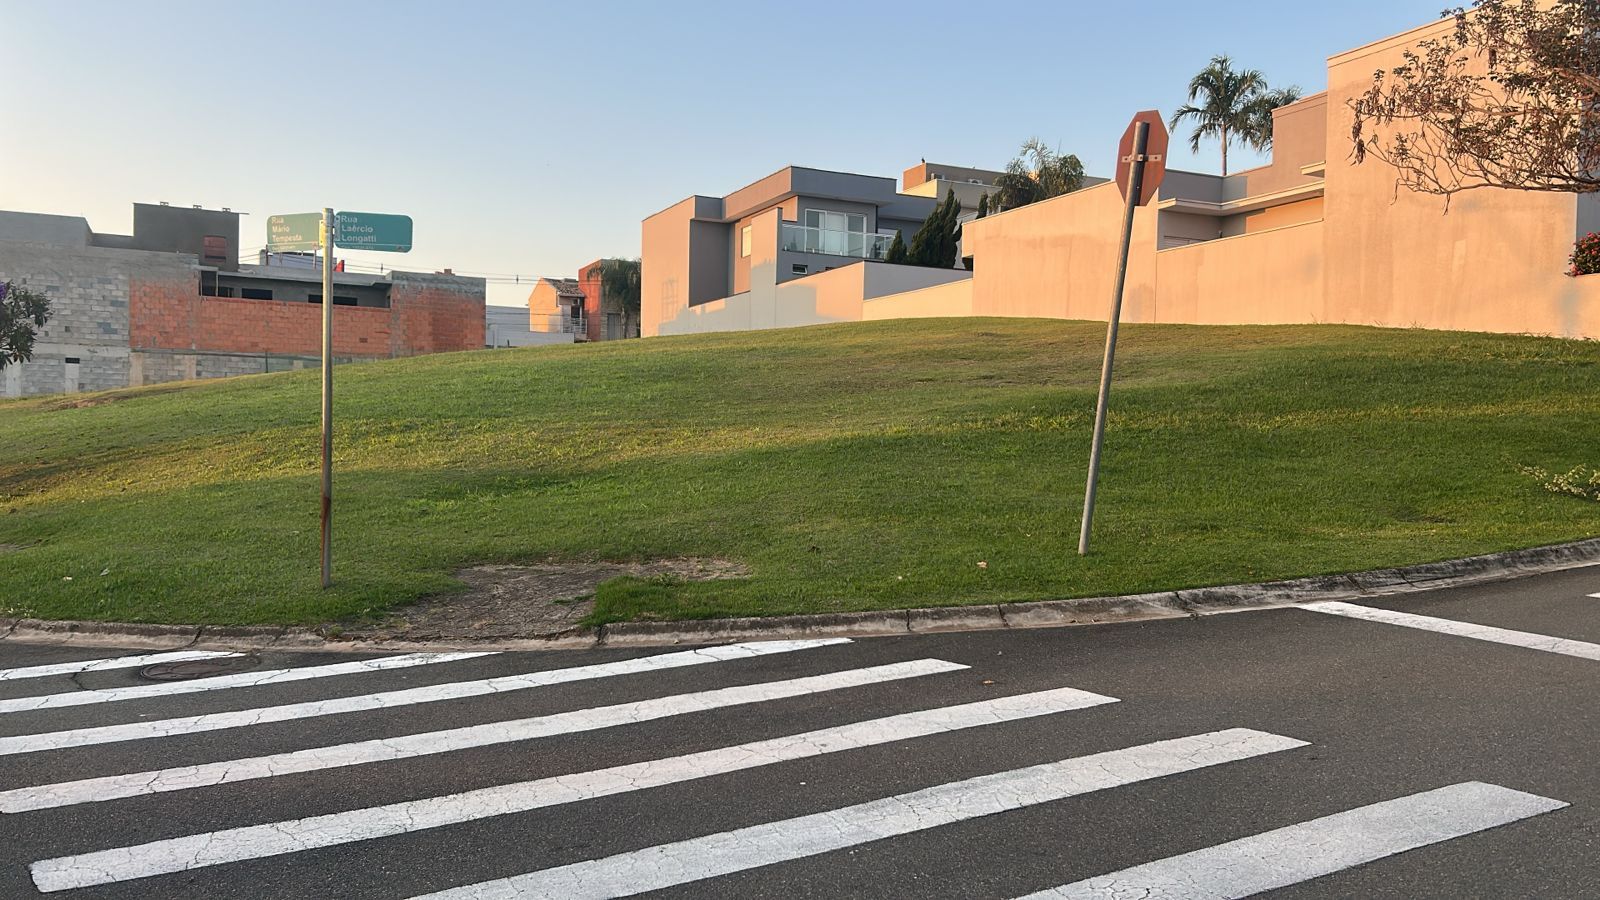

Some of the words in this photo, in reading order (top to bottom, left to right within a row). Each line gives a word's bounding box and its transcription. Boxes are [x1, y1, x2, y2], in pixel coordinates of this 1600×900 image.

[271, 216, 284, 224] Rua
[341, 215, 358, 223] Rua
[341, 225, 374, 233] Laércio
[272, 234, 303, 242] Tempesta
[341, 234, 377, 243] Longatti
